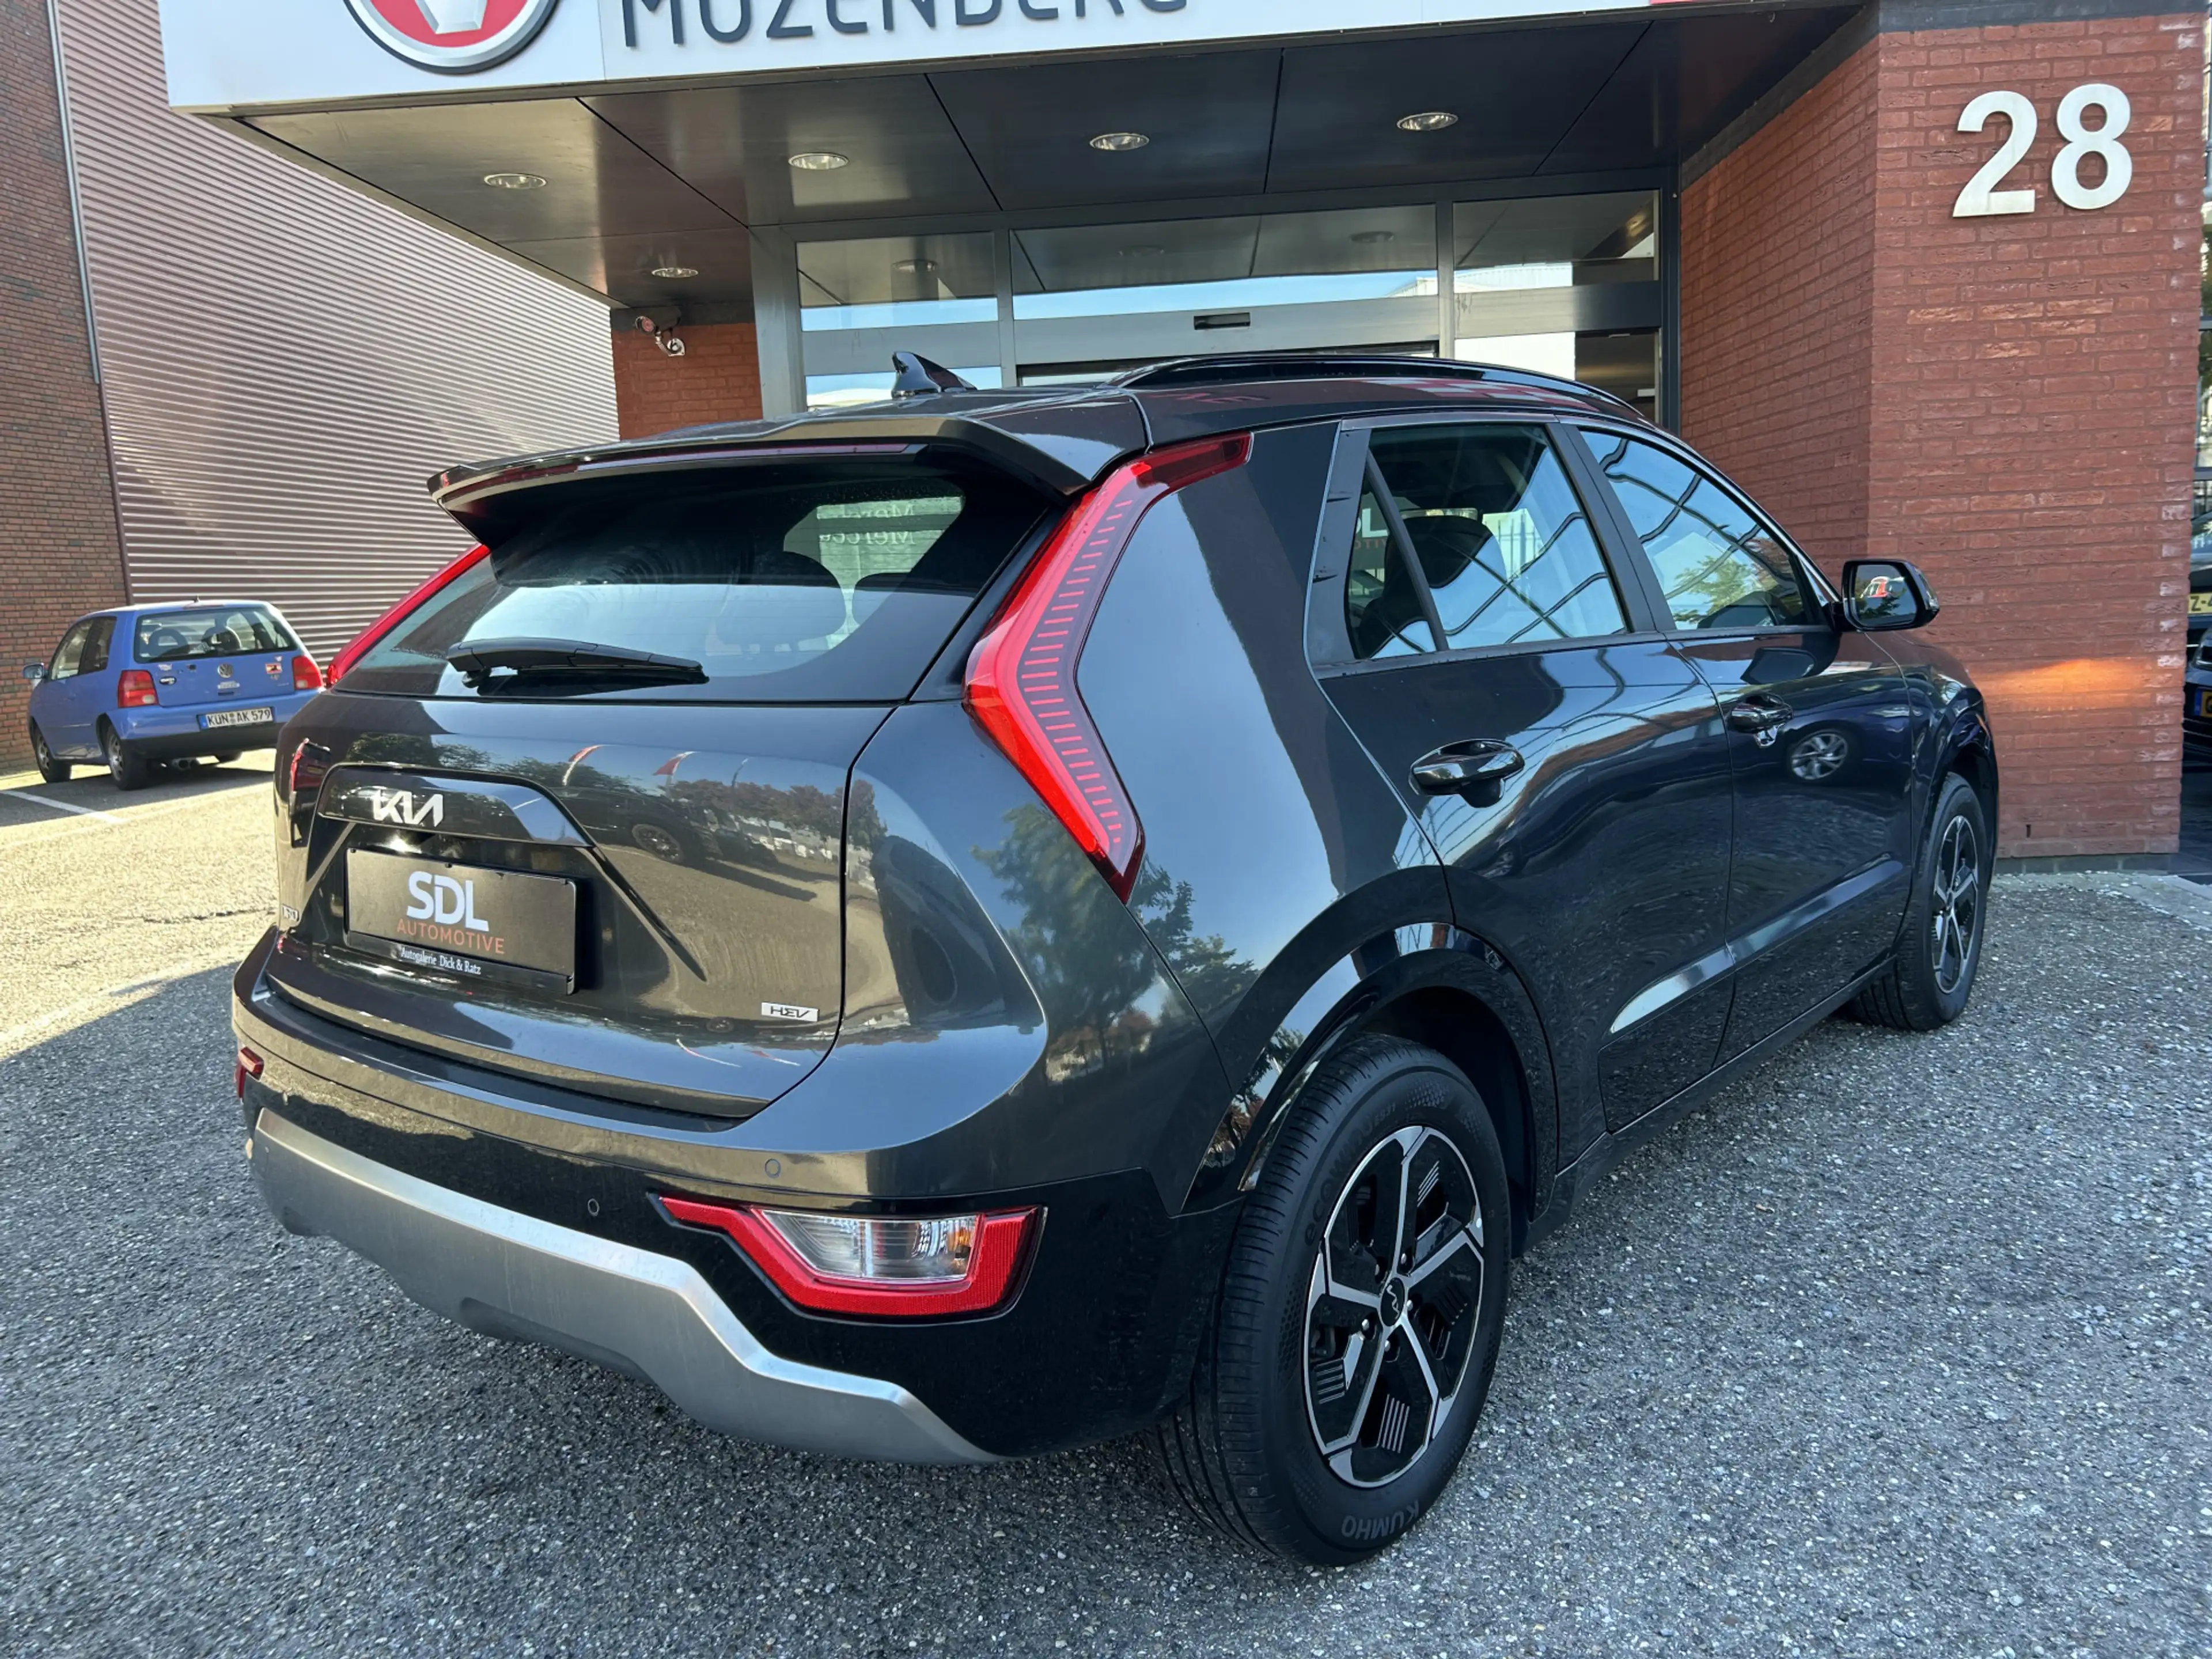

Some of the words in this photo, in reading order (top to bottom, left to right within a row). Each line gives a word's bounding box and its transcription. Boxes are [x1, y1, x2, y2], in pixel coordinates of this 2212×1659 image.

[1952, 83, 2133, 218] 28
[237, 711, 250, 722] AK
[251, 709, 271, 721] 579
[373, 789, 444, 827] KIA
[406, 871, 489, 931] SDL
[397, 918, 505, 955] AUTOMOTIVE
[401, 946, 437, 965] Autogalerie
[440, 955, 456, 969] Dick
[456, 959, 463, 971] &
[464, 961, 481, 975] Ratz
[771, 1006, 810, 1018] HEV
[1341, 1499, 1419, 1540] KUMHO
